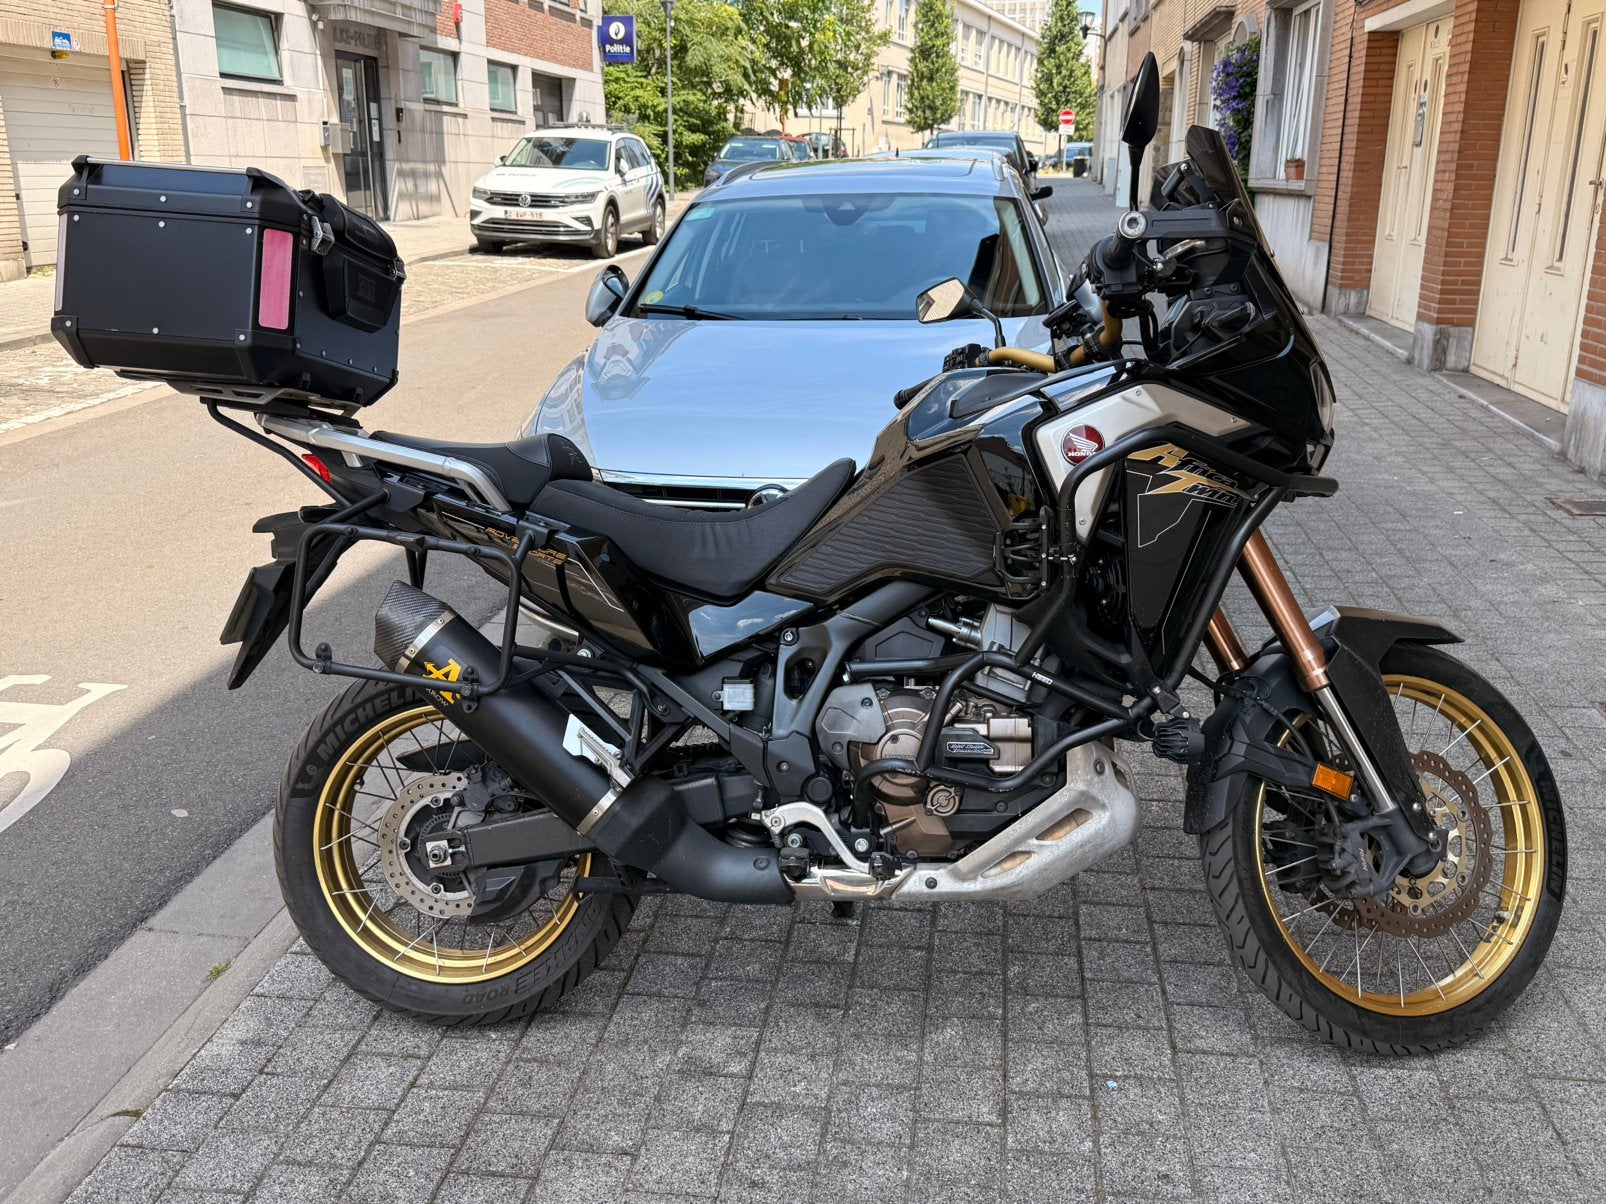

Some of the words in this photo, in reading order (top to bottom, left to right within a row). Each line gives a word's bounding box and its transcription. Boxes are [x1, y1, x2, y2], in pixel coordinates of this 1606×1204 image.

[605, 43, 631, 53] Politie
[317, 687, 423, 762] MICHELI
[1540, 780, 1563, 895] MICHELIN
[462, 986, 510, 1005] ROAD
